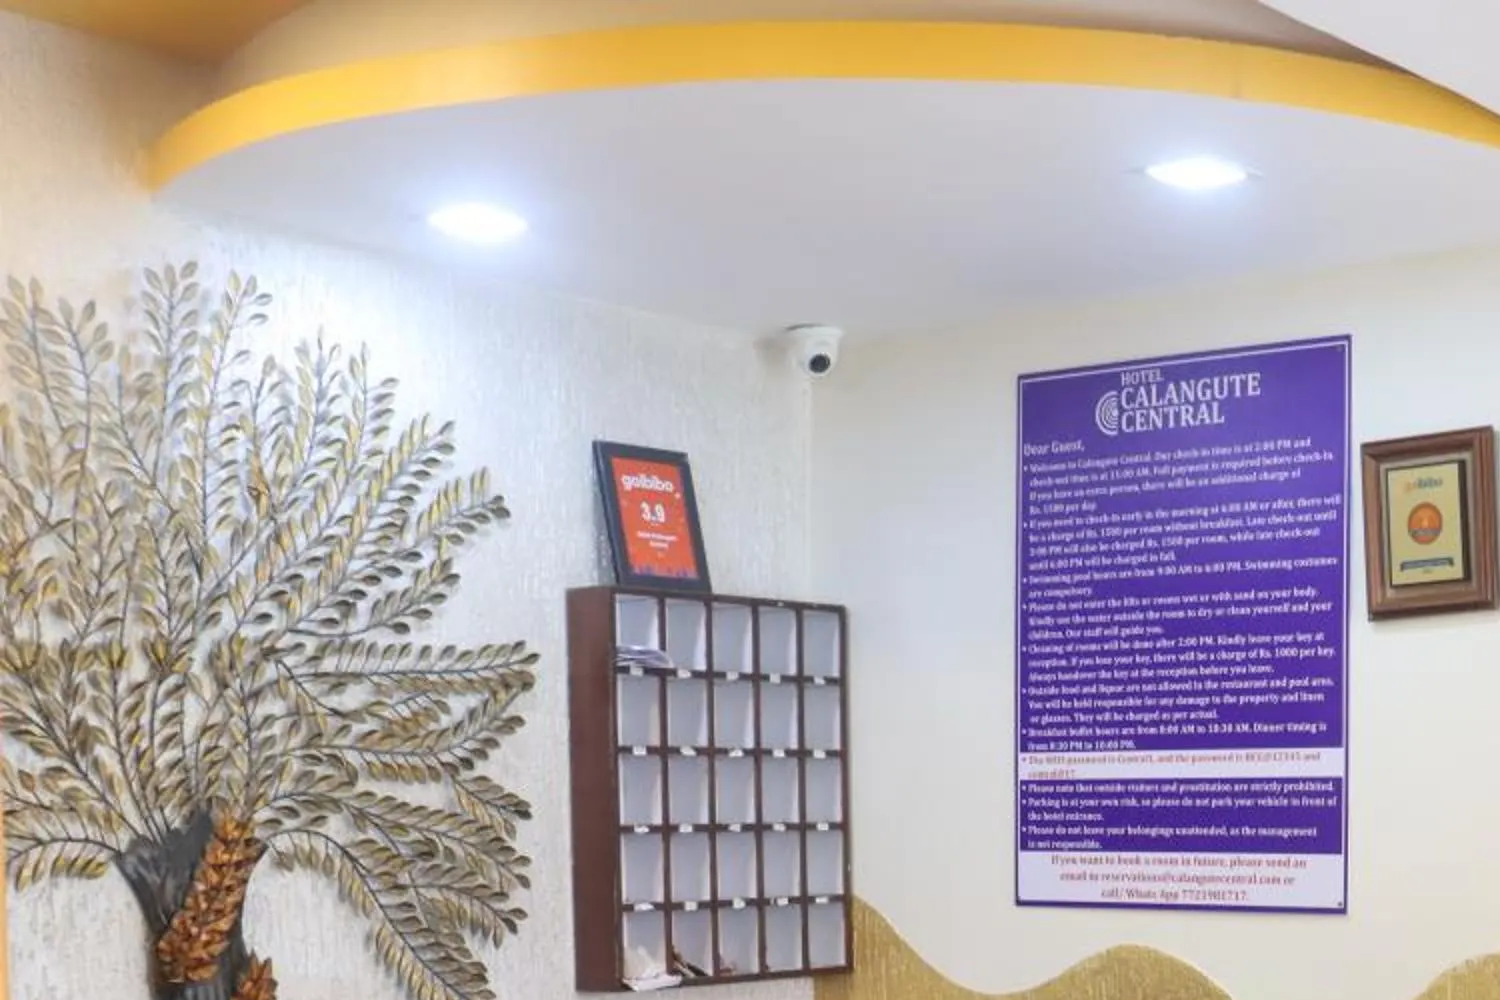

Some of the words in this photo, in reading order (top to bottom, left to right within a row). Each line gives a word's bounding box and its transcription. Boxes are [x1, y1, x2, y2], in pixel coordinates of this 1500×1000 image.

[1120, 368, 1164, 386] HOTEL
[1120, 372, 1261, 410] CALANGUTE
[1121, 401, 1225, 433] CENTRAL
[1023, 442, 1049, 456] Dear
[1051, 439, 1085, 454] Guest,
